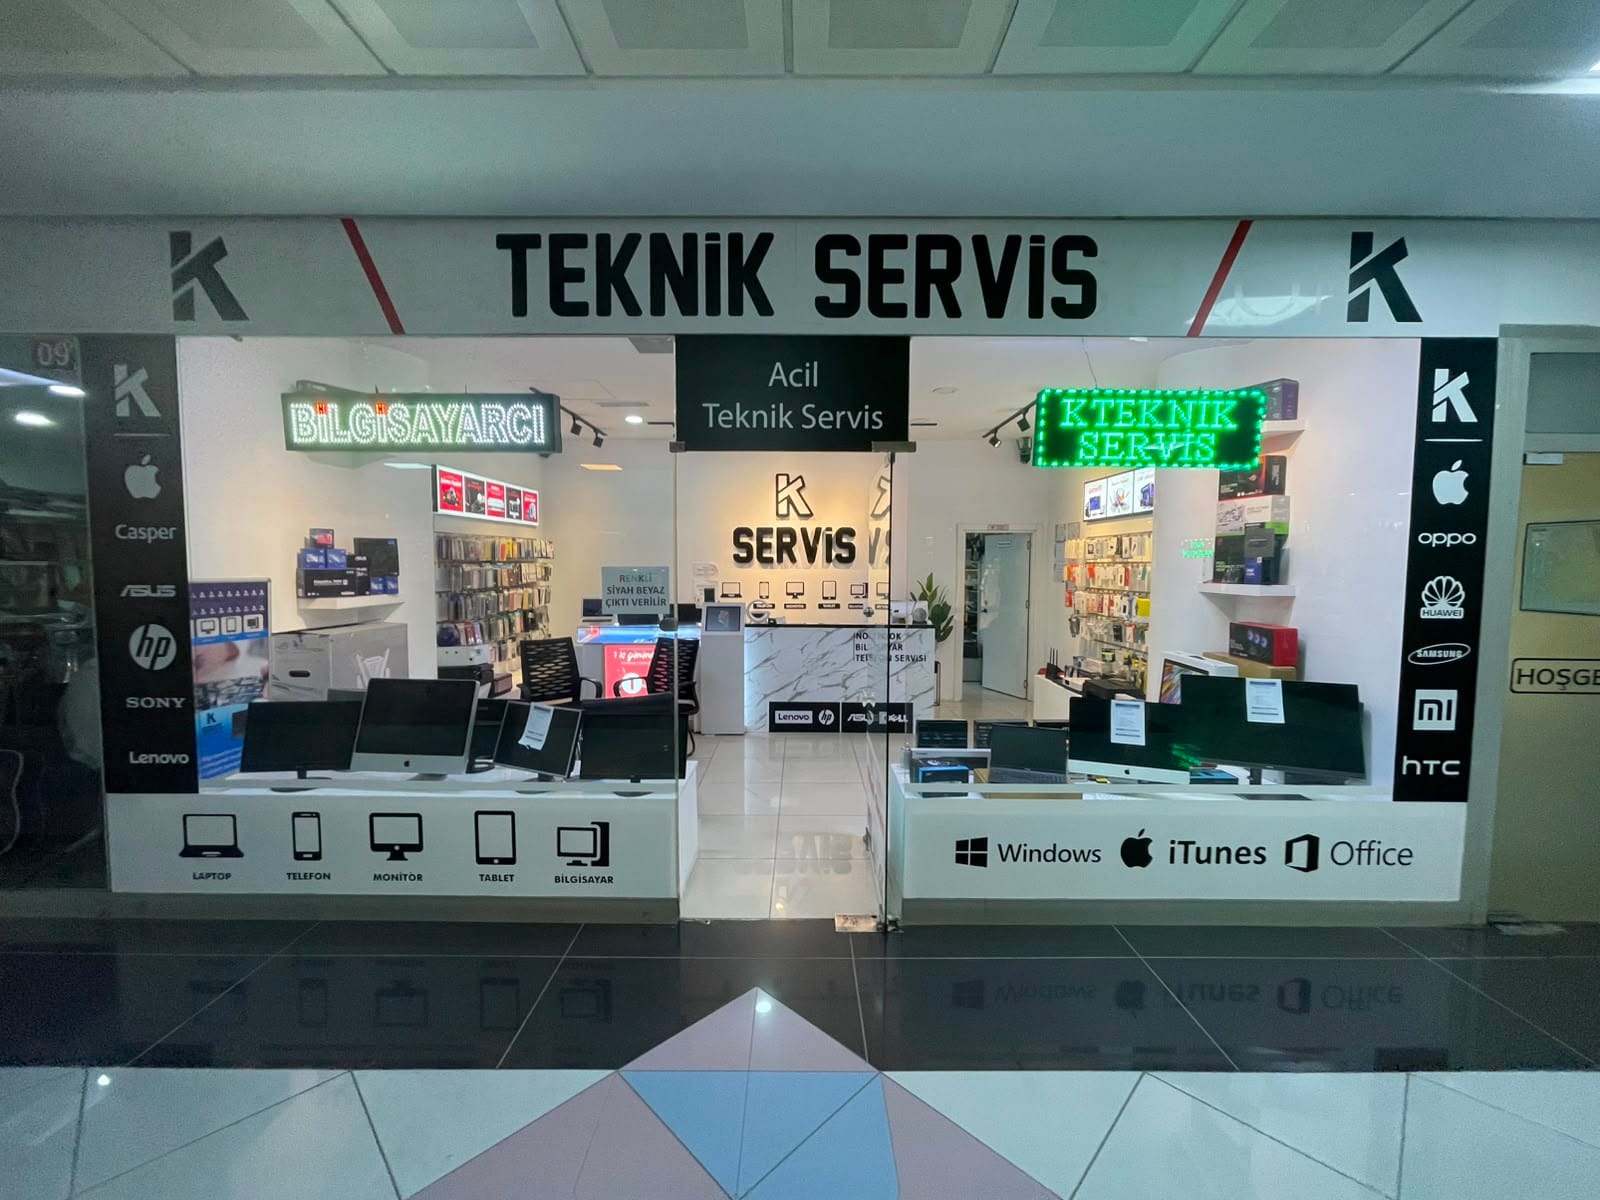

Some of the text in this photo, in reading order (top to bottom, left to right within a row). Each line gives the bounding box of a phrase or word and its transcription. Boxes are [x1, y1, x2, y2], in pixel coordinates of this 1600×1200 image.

[169, 231, 249, 321] K
[1347, 232, 1422, 323] K
[768, 361, 818, 387] Acil
[113, 364, 162, 417] K
[1432, 368, 1478, 422] K
[702, 403, 883, 429] Teknik Servis
[775, 473, 813, 518] K
[115, 524, 177, 543] Casper
[120, 585, 176, 598] ASUS
[606, 584, 665, 595] SİYAH BEYAZ
[605, 596, 667, 609] ÇIKTI VERİLİR
[1422, 609, 1462, 617] HUAWEI
[134, 624, 172, 670] hp
[1416, 650, 1463, 658] SAMSUNG
[126, 697, 186, 709] SONY
[778, 709, 834, 726] Lenovo hp
[129, 751, 189, 765] Lenovo
[998, 841, 1413, 866] Windows iTunes Office
[192, 872, 231, 880] LAPTOP
[286, 872, 331, 881] TELEFON
[479, 874, 515, 882] TABLET
[554, 873, 614, 884] BİLGİSAYAR
